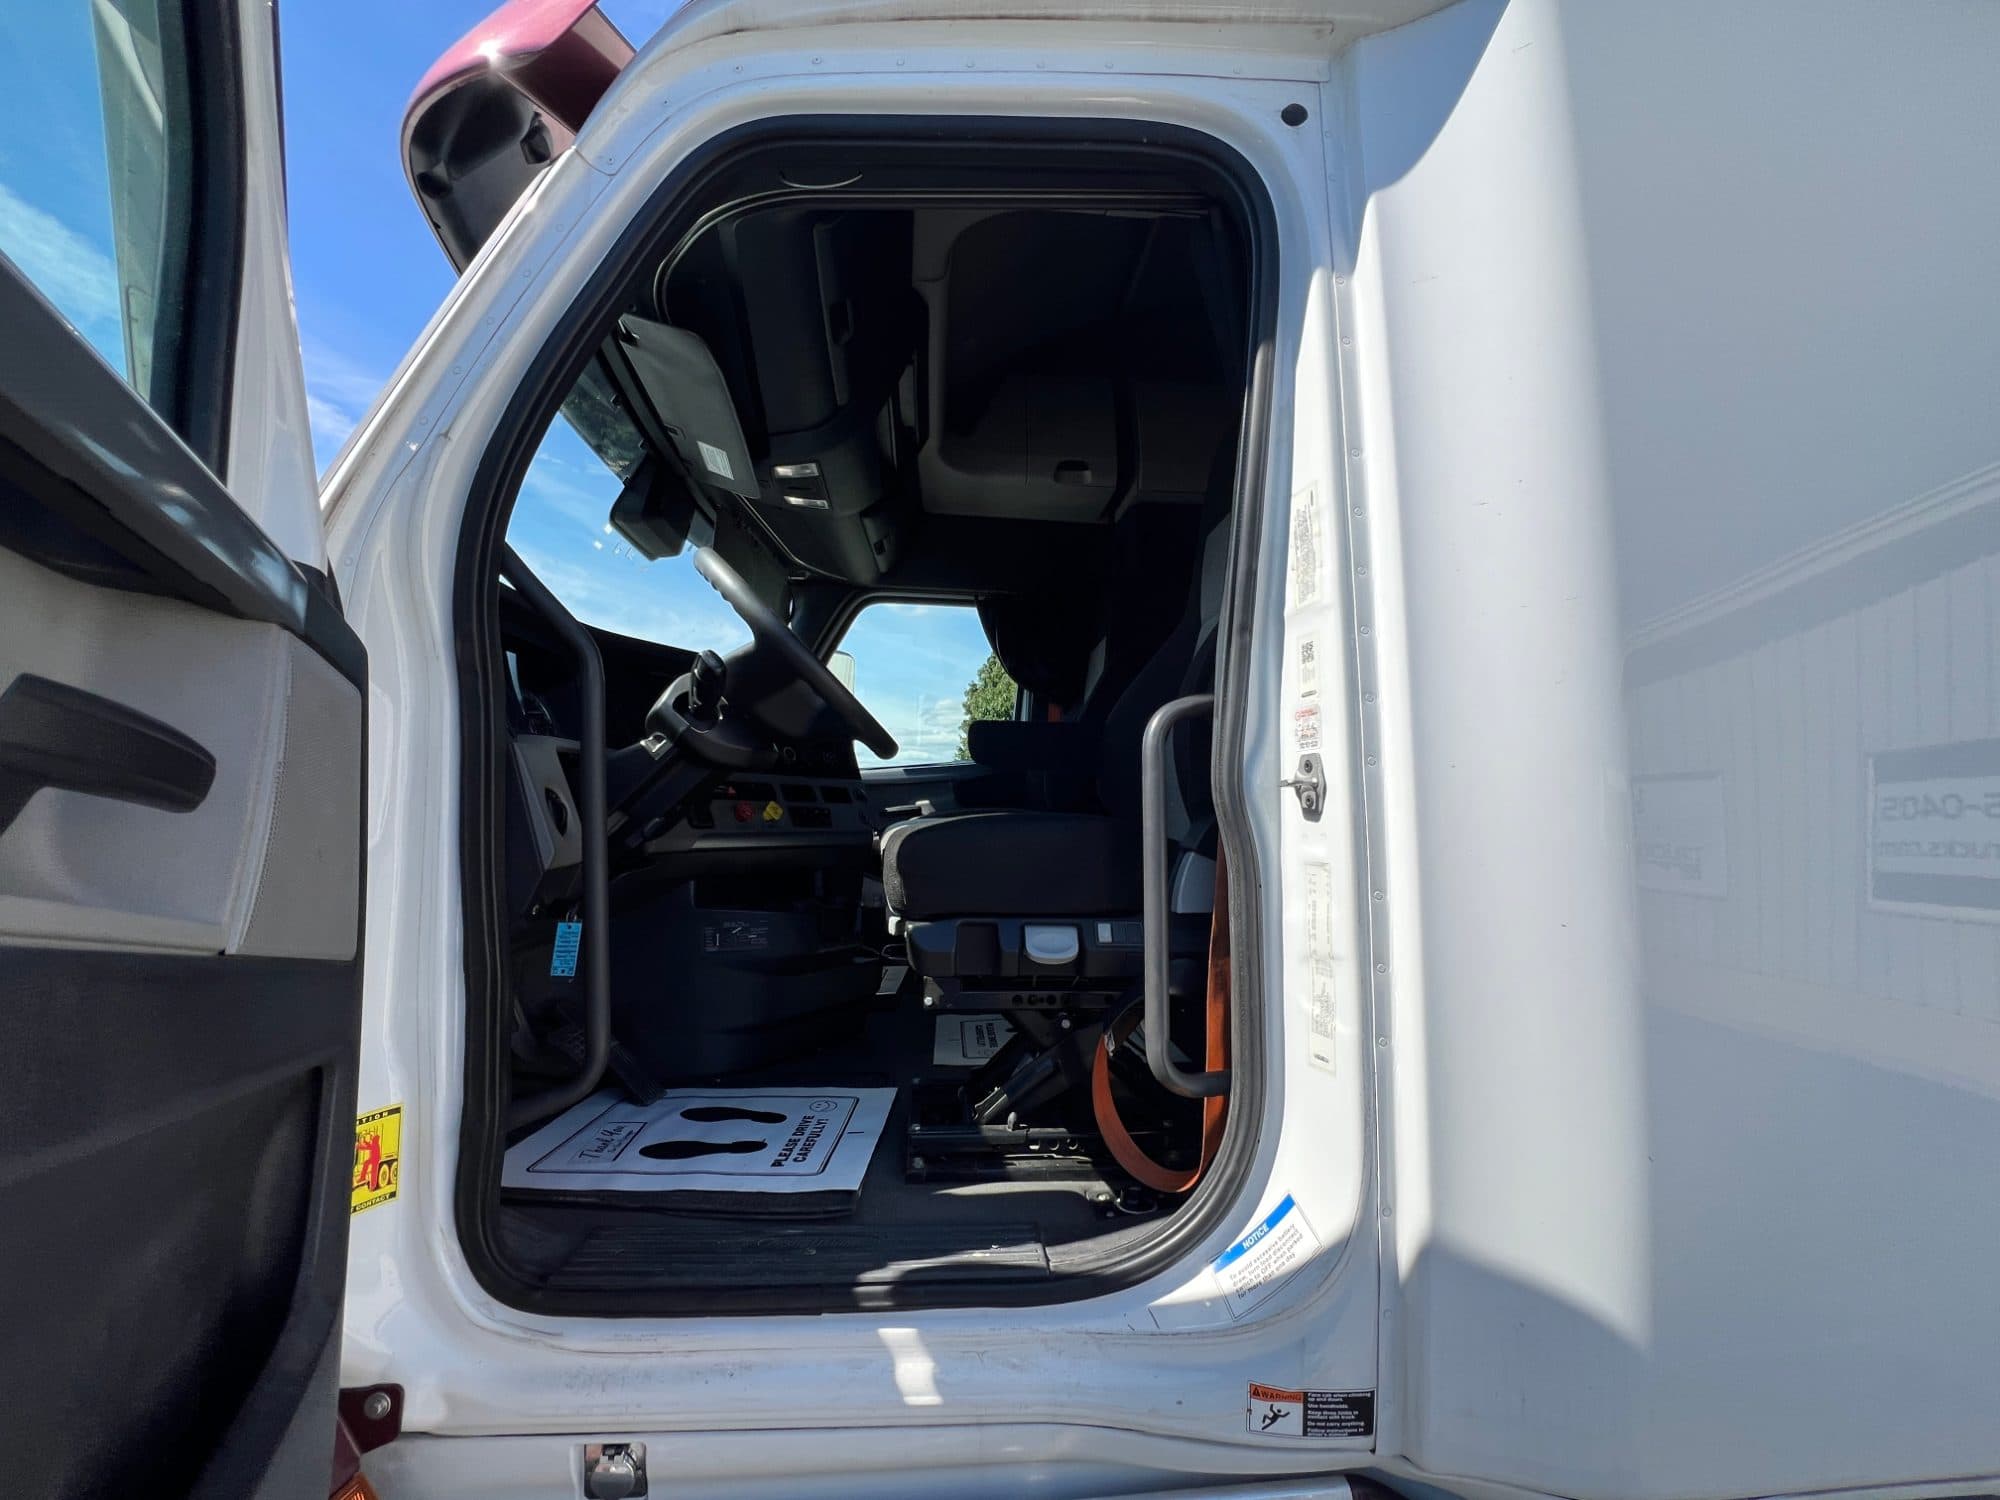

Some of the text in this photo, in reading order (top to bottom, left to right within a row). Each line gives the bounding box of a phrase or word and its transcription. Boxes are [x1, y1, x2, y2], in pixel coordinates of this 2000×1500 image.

[357, 1112, 388, 1124] TION
[579, 1138, 614, 1158] Thank
[771, 1115, 815, 1167] PLEASE DRIVE
[793, 1118, 829, 1162] CAREFULLY!
[356, 1194, 390, 1212] CONTACT
[1242, 1224, 1269, 1250] NOTICE
[1261, 1390, 1302, 1400] WARNING
